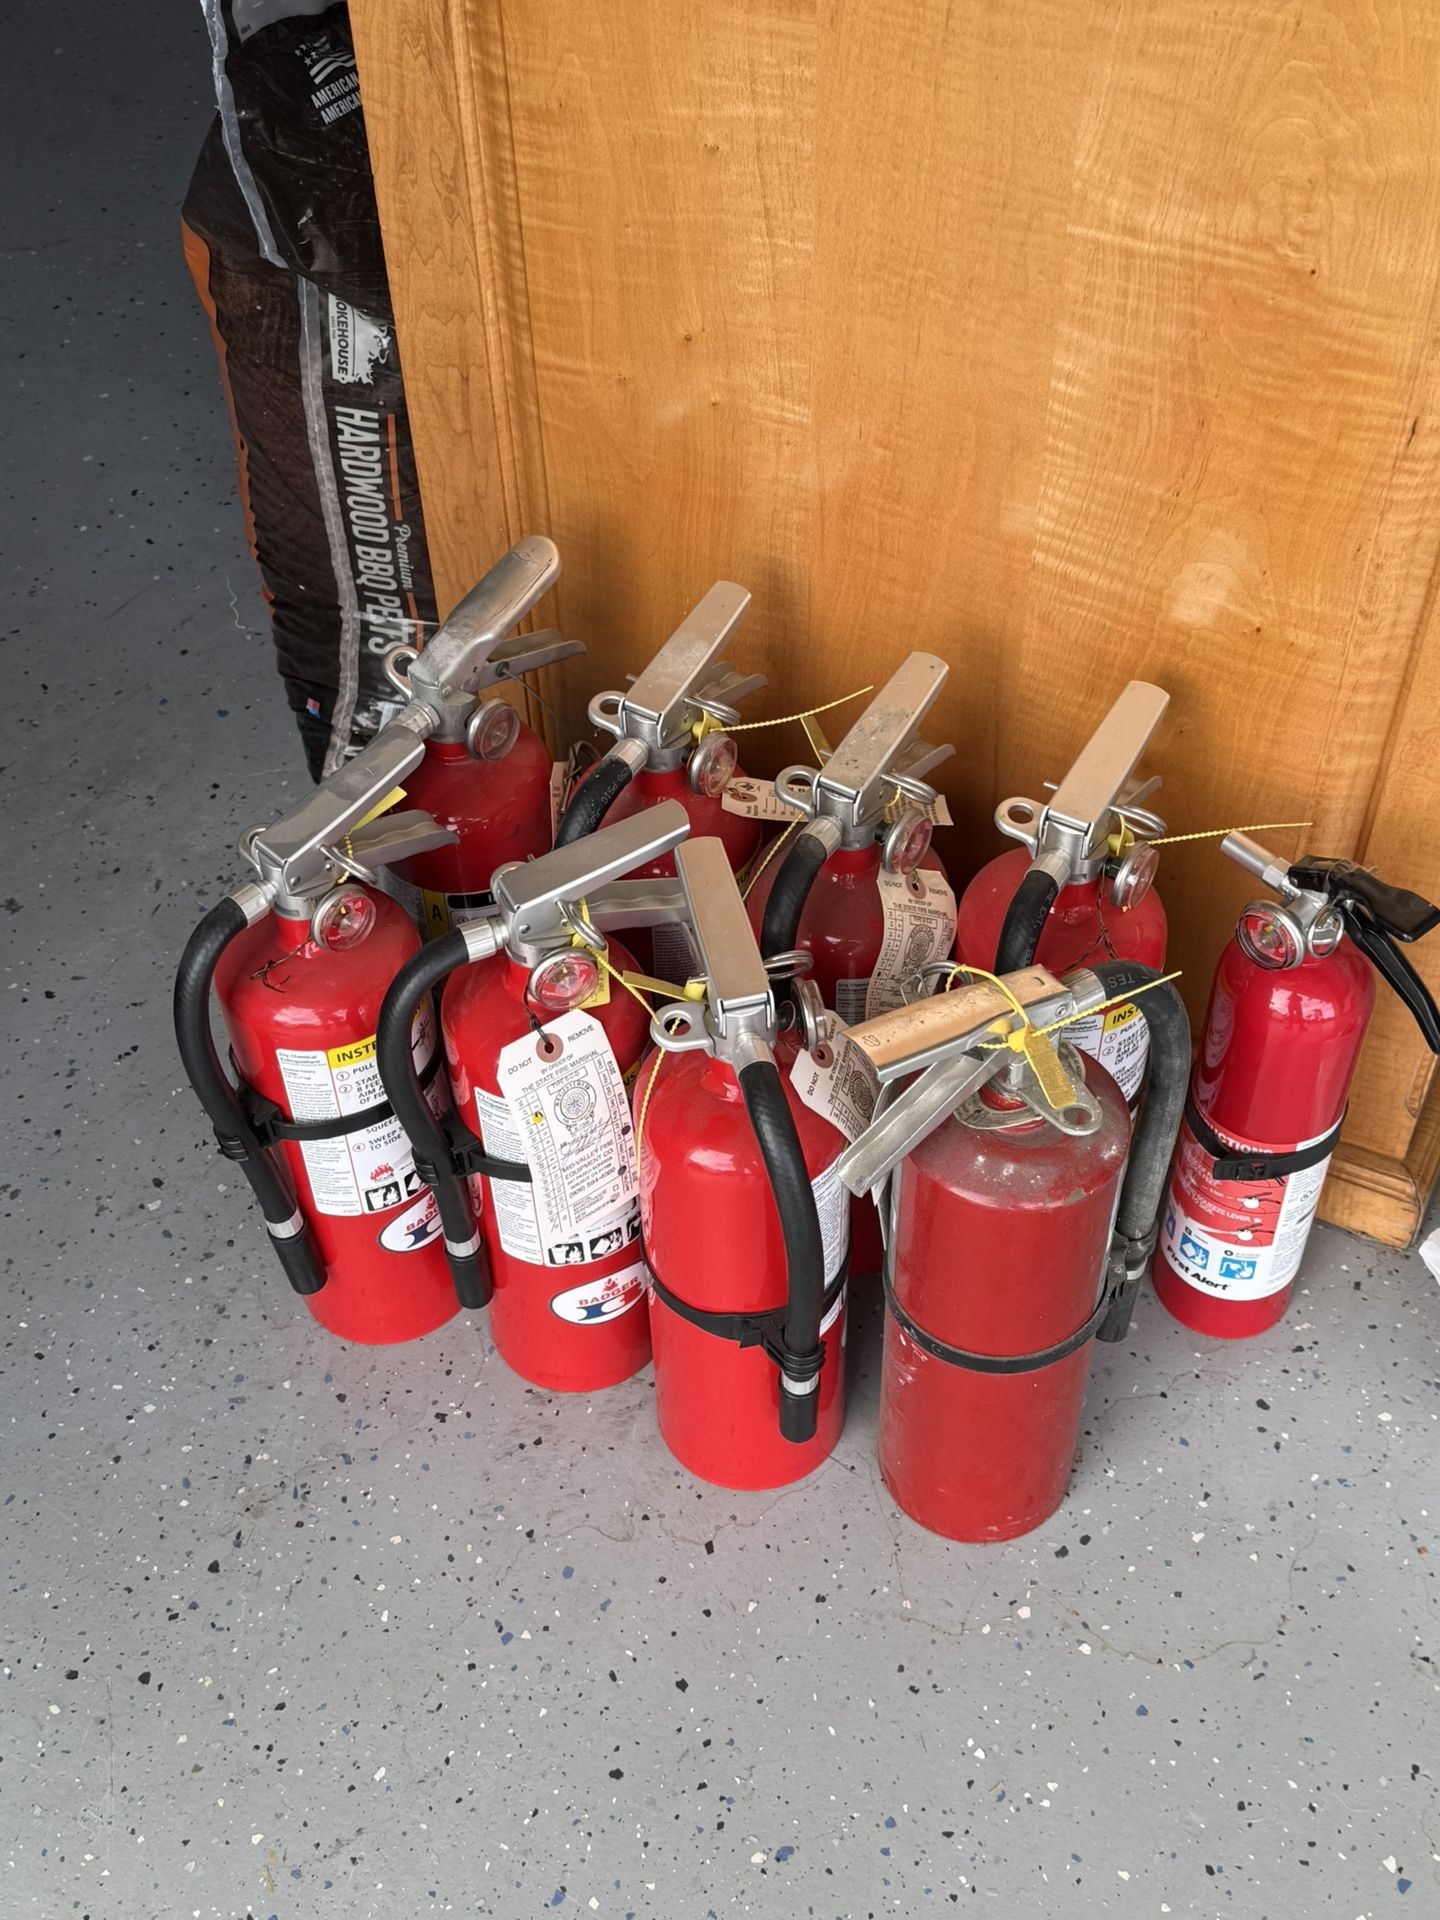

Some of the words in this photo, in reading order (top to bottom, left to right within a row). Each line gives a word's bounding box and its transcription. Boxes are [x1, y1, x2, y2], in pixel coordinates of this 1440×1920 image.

[335, 406, 390, 543] HARDWOOD
[394, 524, 414, 590] Premium
[355, 544, 398, 590] BBQ
[1112, 1007, 1138, 1024] INS
[567, 1025, 593, 1041] REMOVE
[352, 1062, 376, 1074] PULL
[507, 1065, 518, 1073] DO
[518, 1058, 532, 1068] NOT
[522, 1084, 534, 1092] THE
[535, 1073, 554, 1085] STATE
[555, 1065, 568, 1074] FIRE
[570, 1050, 598, 1066] MARSHAL
[810, 1073, 819, 1084] NOT
[358, 1088, 376, 1098] AIM
[806, 1085, 815, 1095] DO
[360, 1096, 370, 1105] OF
[369, 1129, 396, 1145] SWEEP
[370, 1142, 381, 1151] TO
[560, 1147, 600, 1172] MID-VALLEY
[563, 1154, 603, 1179] EQUIPMENT
[1166, 1244, 1190, 1273] First
[1191, 1272, 1228, 1290] Alert
[578, 1276, 638, 1306] BADGER
